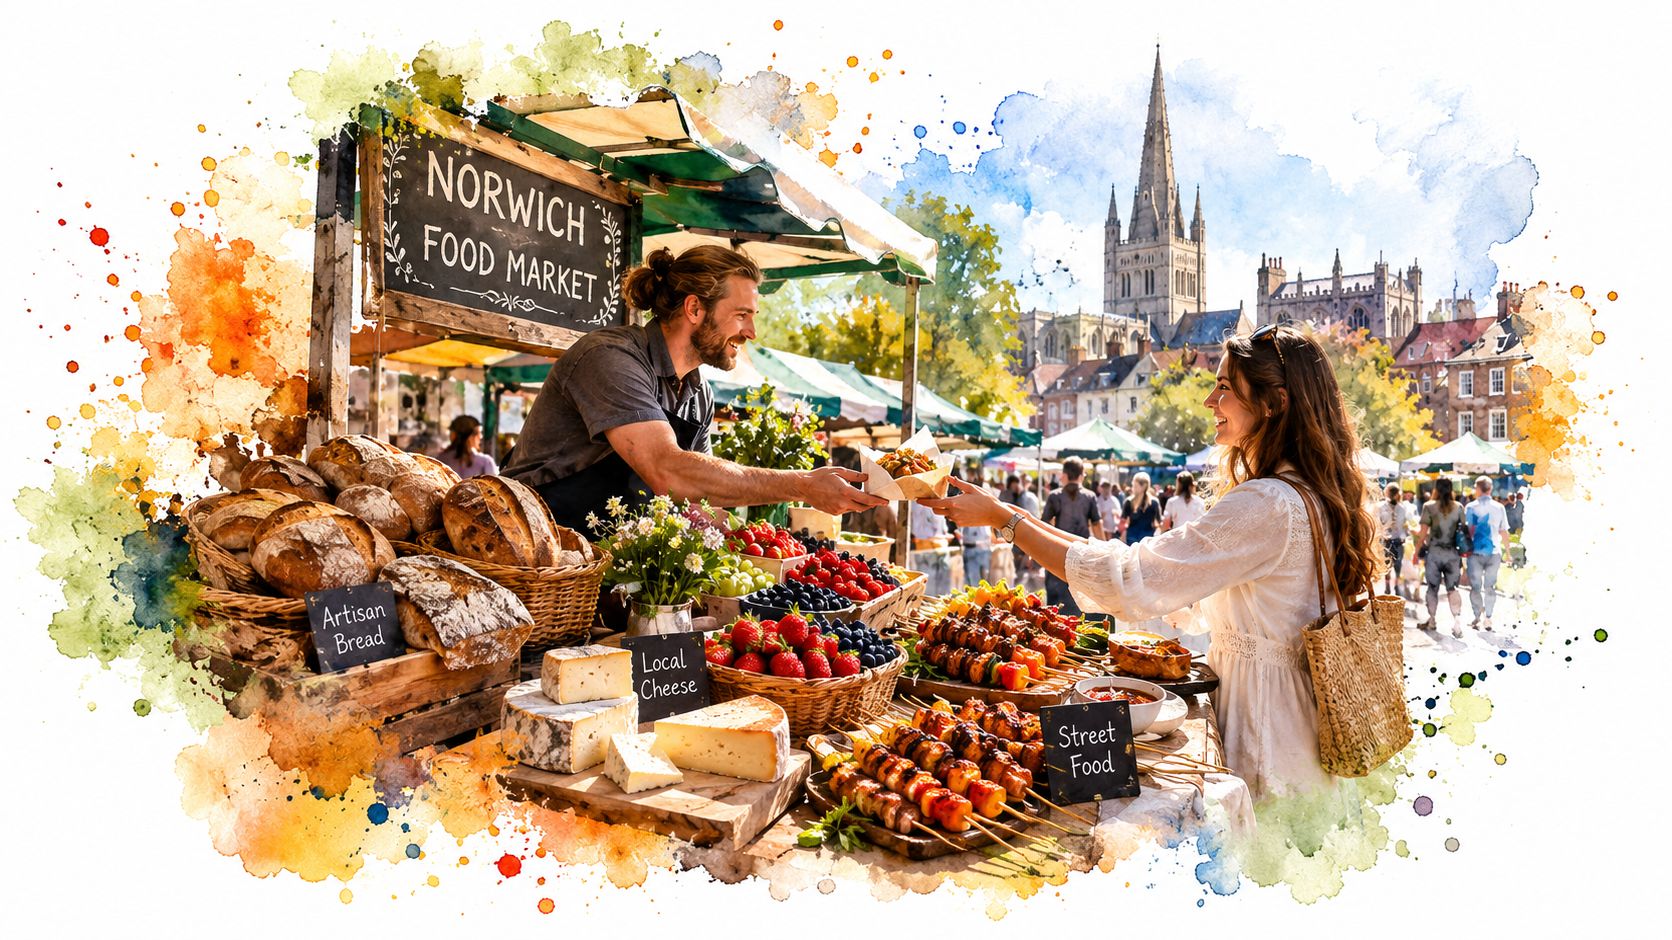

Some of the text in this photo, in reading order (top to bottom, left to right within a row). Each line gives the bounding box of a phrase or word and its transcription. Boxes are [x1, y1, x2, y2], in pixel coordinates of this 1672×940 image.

[427, 150, 585, 246] NORWICH
[424, 223, 598, 303] FOOD MARKET
[323, 604, 386, 630] Artisan
[332, 624, 386, 655] Bread
[642, 647, 687, 674] Local
[641, 678, 698, 700] Cheese
[1058, 720, 1116, 748] Street
[1070, 749, 1116, 779] Food
